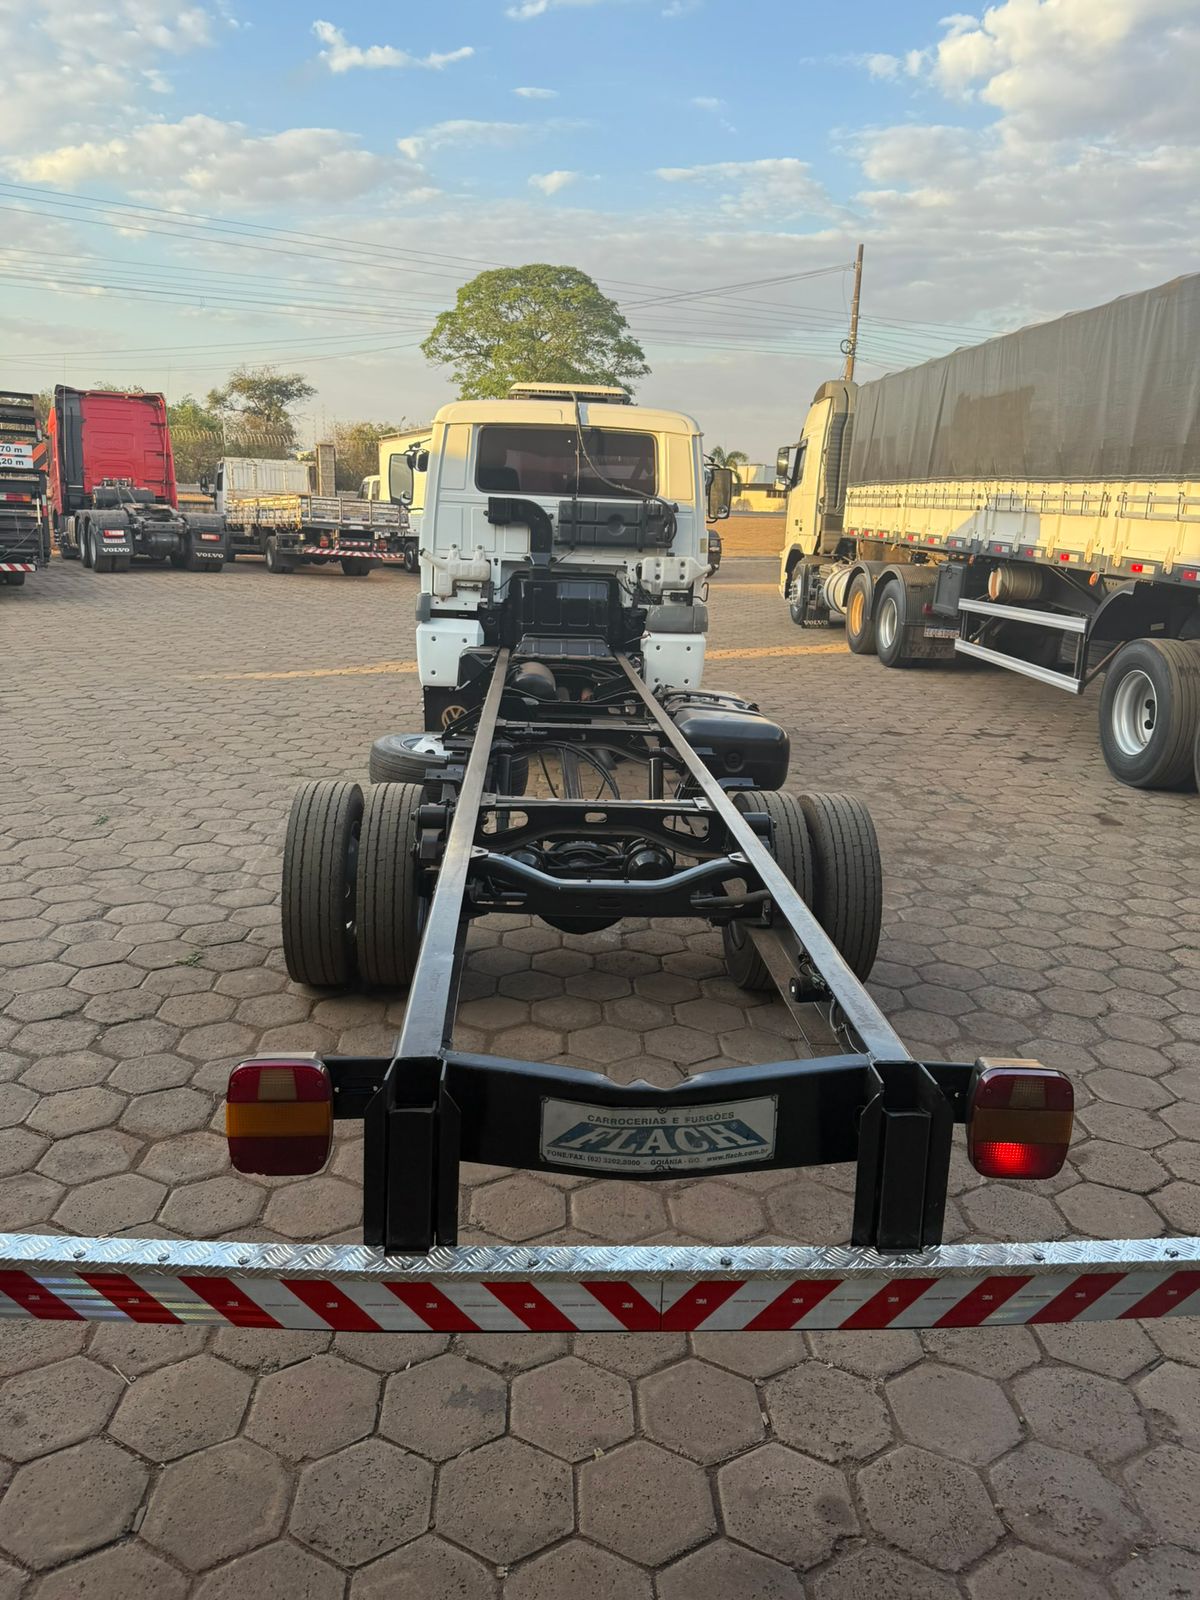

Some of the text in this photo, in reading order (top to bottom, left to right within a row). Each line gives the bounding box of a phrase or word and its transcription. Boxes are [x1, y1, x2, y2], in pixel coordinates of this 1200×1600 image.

[587, 1114, 666, 1126] CARROCERIAS
[558, 1124, 759, 1154] FLACH
[707, 1148, 769, 1162] www.flach.com.br
